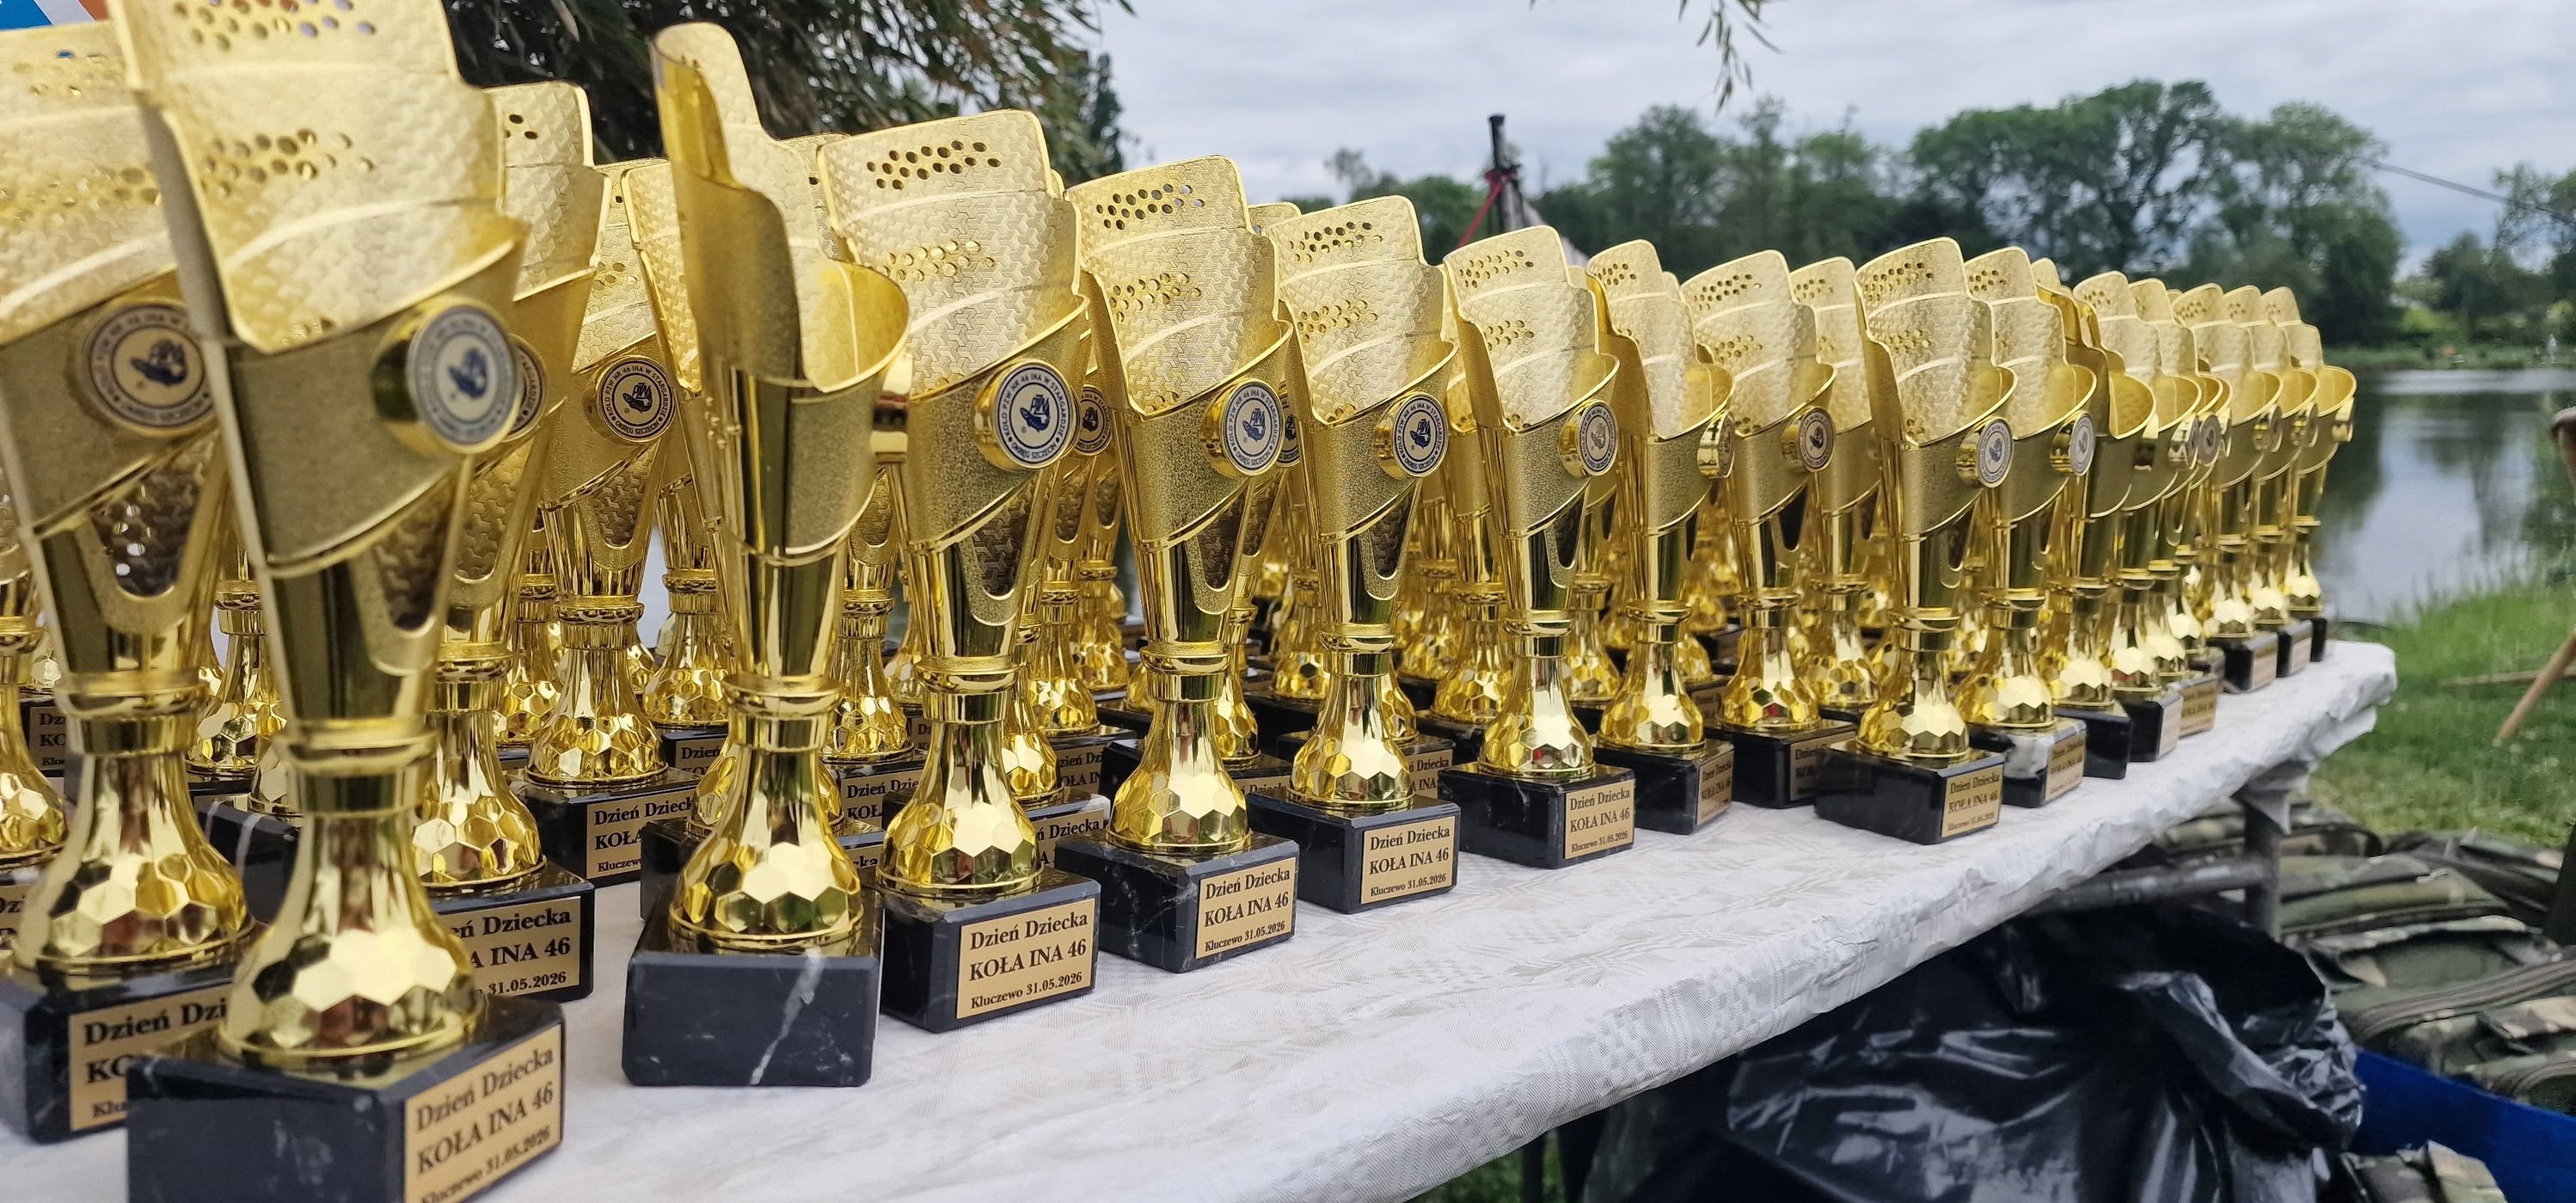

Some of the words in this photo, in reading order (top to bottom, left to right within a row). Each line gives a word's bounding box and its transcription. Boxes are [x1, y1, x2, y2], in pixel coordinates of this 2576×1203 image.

[1059, 754, 1082, 767] zień
[1417, 757, 1450, 770] Dziecka
[847, 781, 886, 798] Dzień
[890, 778, 918, 791] Dzie
[1061, 774, 1087, 787] OŁA
[1419, 777, 1436, 790] INA
[594, 805, 640, 826] Dzień
[644, 796, 693, 817] Dzieck
[847, 805, 882, 820] KOŁ
[1570, 795, 1595, 811] Dzień
[1598, 788, 1630, 805] Dziecka
[1049, 819, 1099, 839] Dziecka
[1570, 815, 1598, 832] KOŁA
[1600, 810, 1618, 826] INA
[1620, 807, 1630, 820] 46
[1369, 832, 1403, 851] Dzień
[1407, 826, 1450, 844] Dziecka
[598, 858, 641, 872] Kluczew
[1369, 855, 1407, 875] KOŁA
[1410, 850, 1433, 867] INA
[1436, 847, 1449, 862] 46
[1205, 877, 1242, 899] Dzień
[1244, 867, 1290, 891] Dziecka
[1371, 884, 1406, 897] Kluczewo
[1408, 874, 1446, 889] 31.05.2026
[482, 908, 571, 936] Dziecka
[1204, 903, 1244, 927] KOŁA
[1247, 896, 1273, 917] INA
[1274, 891, 1289, 909] 46
[970, 924, 1020, 951] Dzień
[1025, 911, 1088, 939] Dziecka
[1205, 935, 1242, 952] Kluczewo
[1245, 920, 1285, 942] 31.05.2026
[490, 942, 538, 967] INA
[544, 936, 571, 956] 46
[968, 953, 1025, 982] KOŁA
[1028, 944, 1064, 968] INA
[1067, 939, 1087, 958] 46
[488, 972, 567, 995] 31.05.2026
[972, 989, 1023, 1010] Kluczewo
[1027, 972, 1082, 996] 31.05.2026
[84, 1008, 169, 1046] Dzień
[418, 1083, 474, 1131] Dzień
[482, 1049, 554, 1097] Dziecka
[488, 1099, 527, 1135] INA
[532, 1082, 554, 1109] 46
